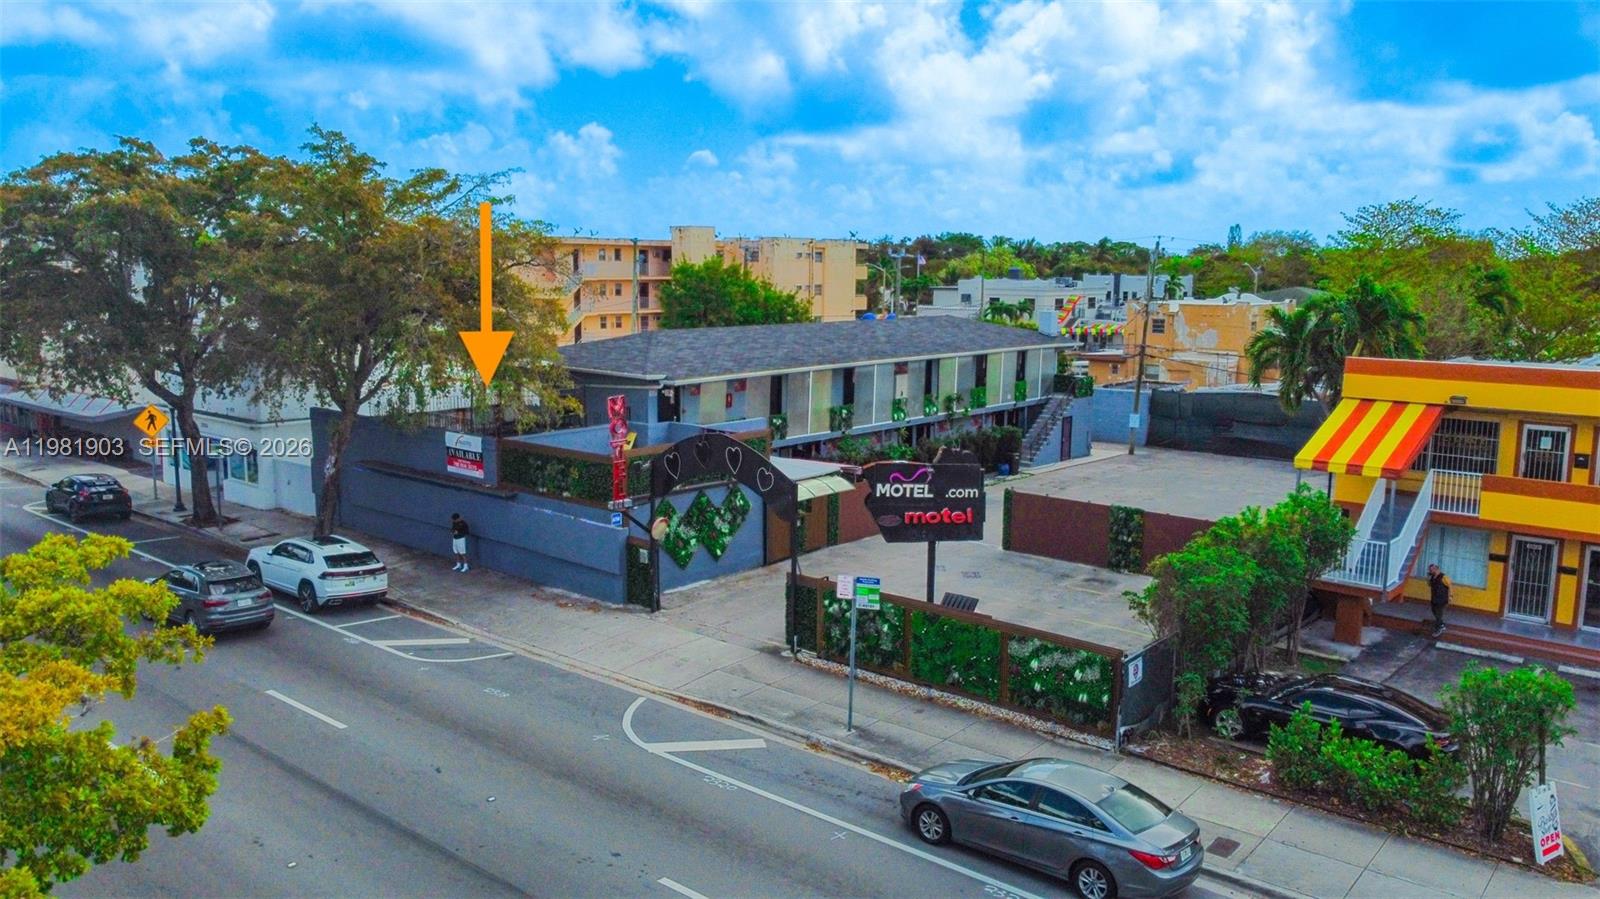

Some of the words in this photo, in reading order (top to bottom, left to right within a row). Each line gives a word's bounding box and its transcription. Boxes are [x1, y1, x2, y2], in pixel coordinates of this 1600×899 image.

[448, 448, 481, 461] AVAILABLE
[876, 483, 934, 498] MOTEL
[945, 488, 979, 498] .com
[904, 507, 974, 526] motel
[1540, 831, 1561, 848] OPEN
